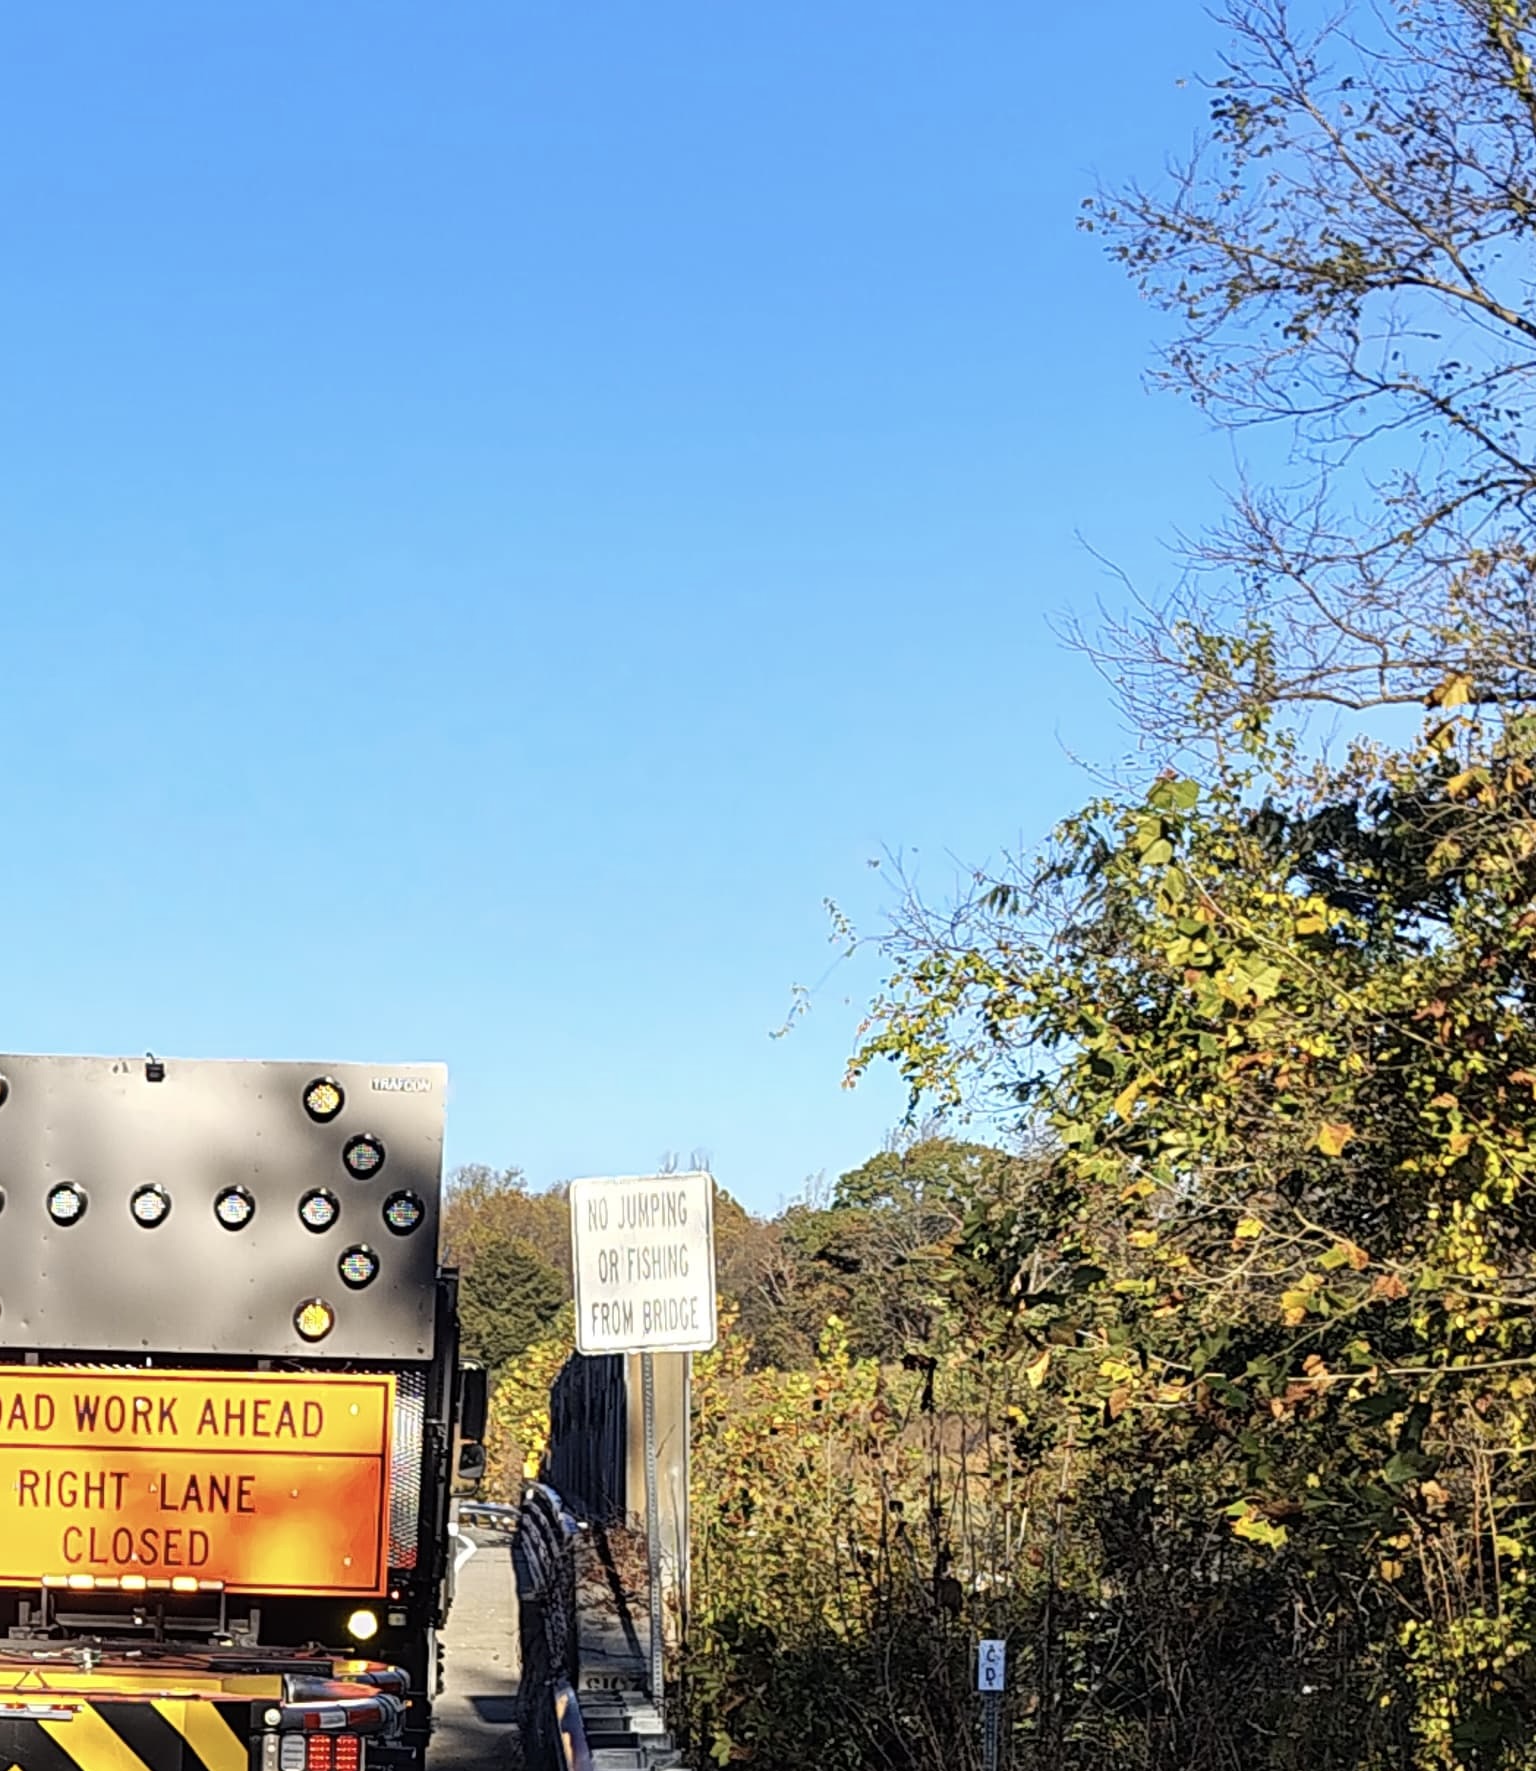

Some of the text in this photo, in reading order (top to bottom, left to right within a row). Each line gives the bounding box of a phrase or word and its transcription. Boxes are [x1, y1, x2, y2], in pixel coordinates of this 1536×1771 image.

[587, 1190, 688, 1232] NO JUMPING
[598, 1245, 689, 1283] OR FISHING
[591, 1296, 699, 1336] FROM BRIDGE
[74, 1394, 178, 1435] WORK
[196, 1399, 324, 1438] AHEAD
[17, 1469, 257, 1514] RIGHT LANE
[62, 1526, 210, 1567] CLOSED
[985, 1667, 996, 1681] D
